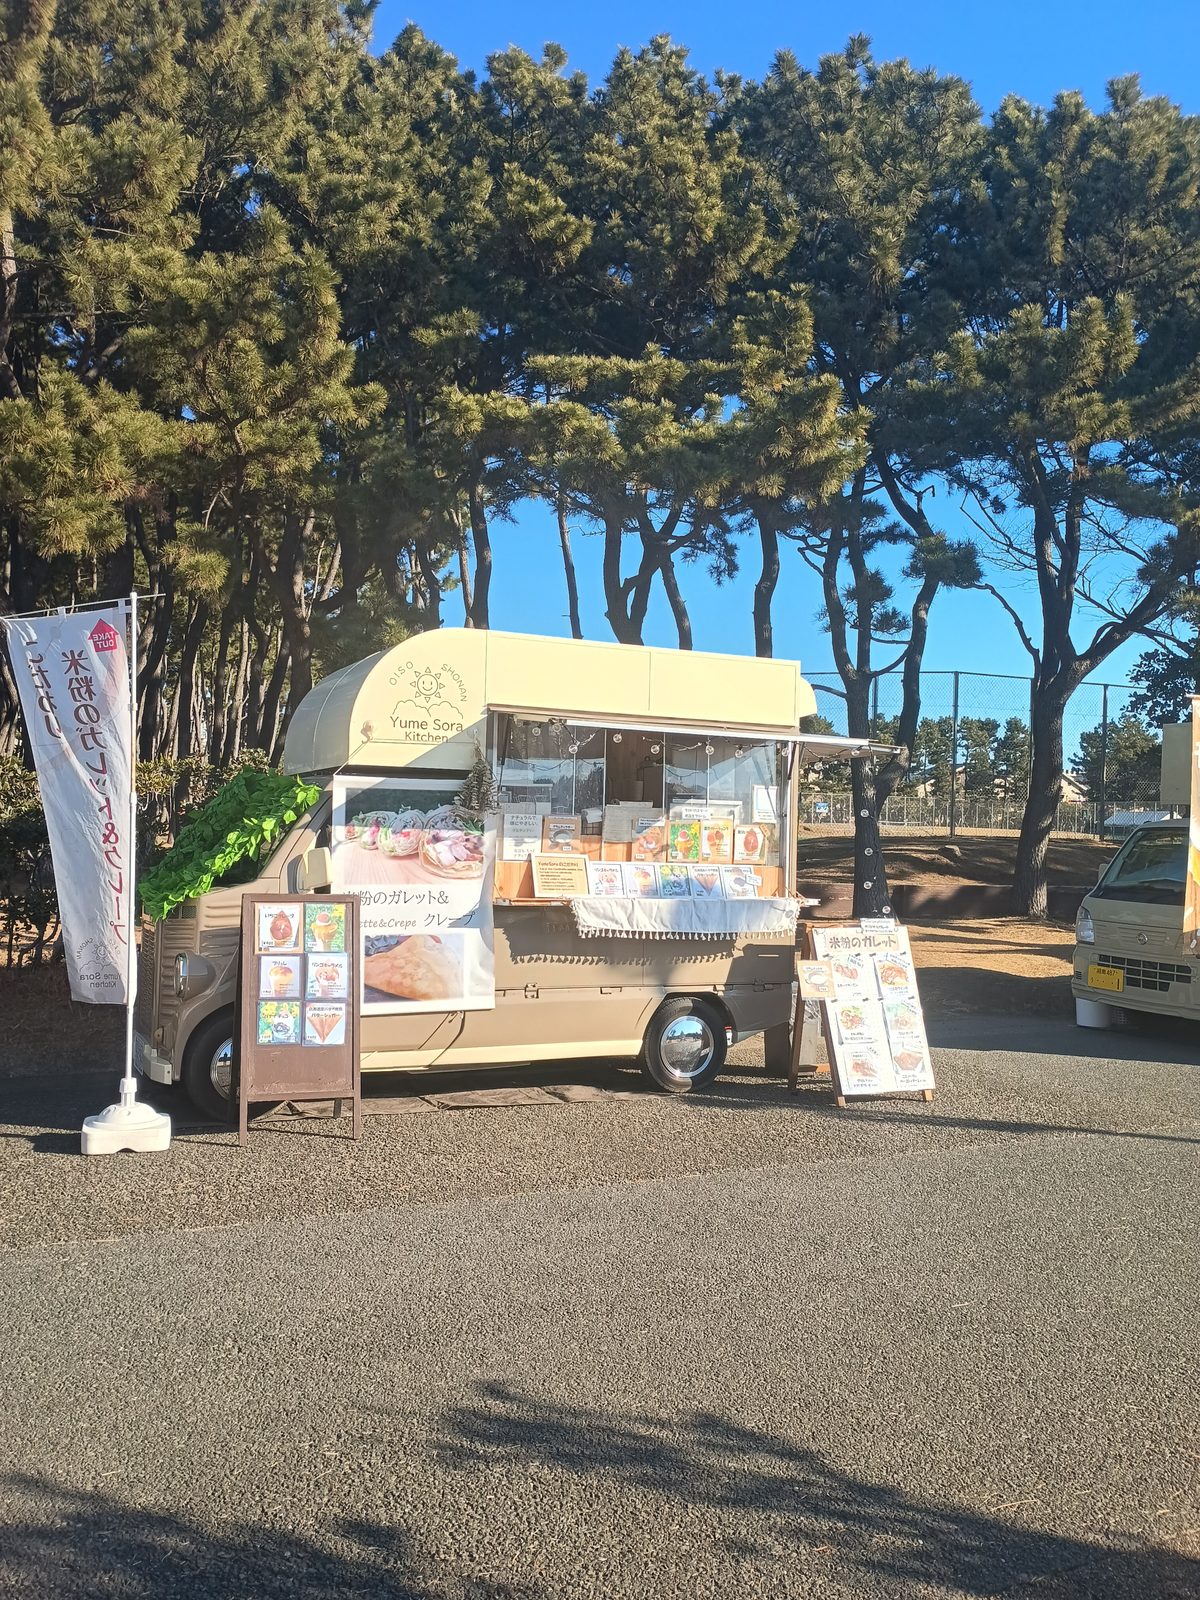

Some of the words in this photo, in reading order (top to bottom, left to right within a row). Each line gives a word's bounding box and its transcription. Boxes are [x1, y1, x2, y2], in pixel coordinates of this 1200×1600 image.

[389, 660, 414, 686] OISO
[441, 663, 468, 702] SHONAN
[390, 715, 428, 730] Yume
[432, 718, 463, 732] Sora
[404, 731, 449, 743] Kitchen
[359, 917, 417, 930] ette&Crepe
[424, 911, 476, 928] クレープ
[829, 935, 897, 949] 米粉のガレット
